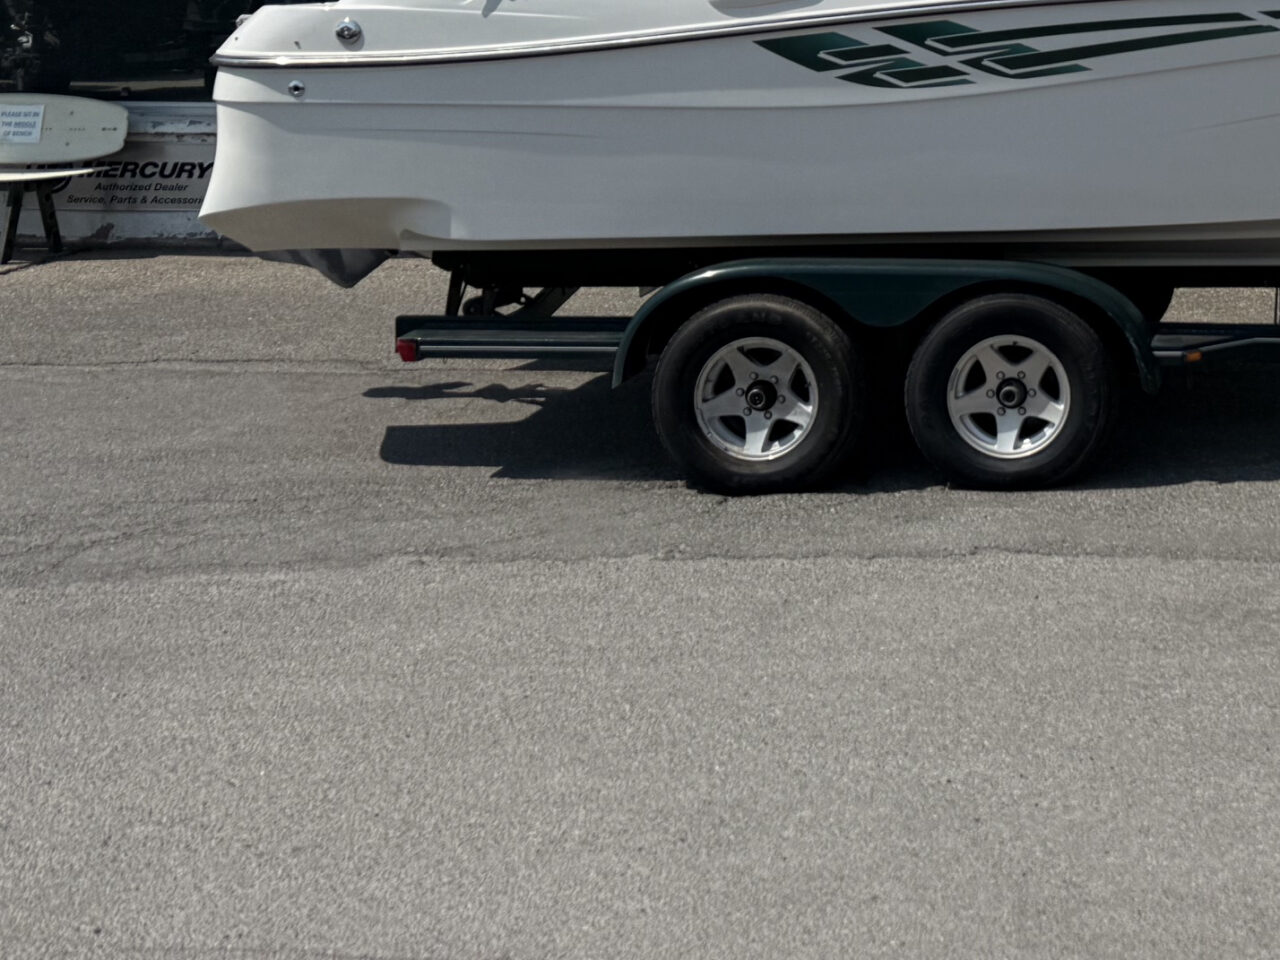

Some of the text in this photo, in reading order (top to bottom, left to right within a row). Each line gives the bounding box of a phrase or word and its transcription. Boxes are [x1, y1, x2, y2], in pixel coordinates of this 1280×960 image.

[94, 182, 189, 192] Authorized Dealer
[66, 194, 203, 205] Service, Parts & Accessori
